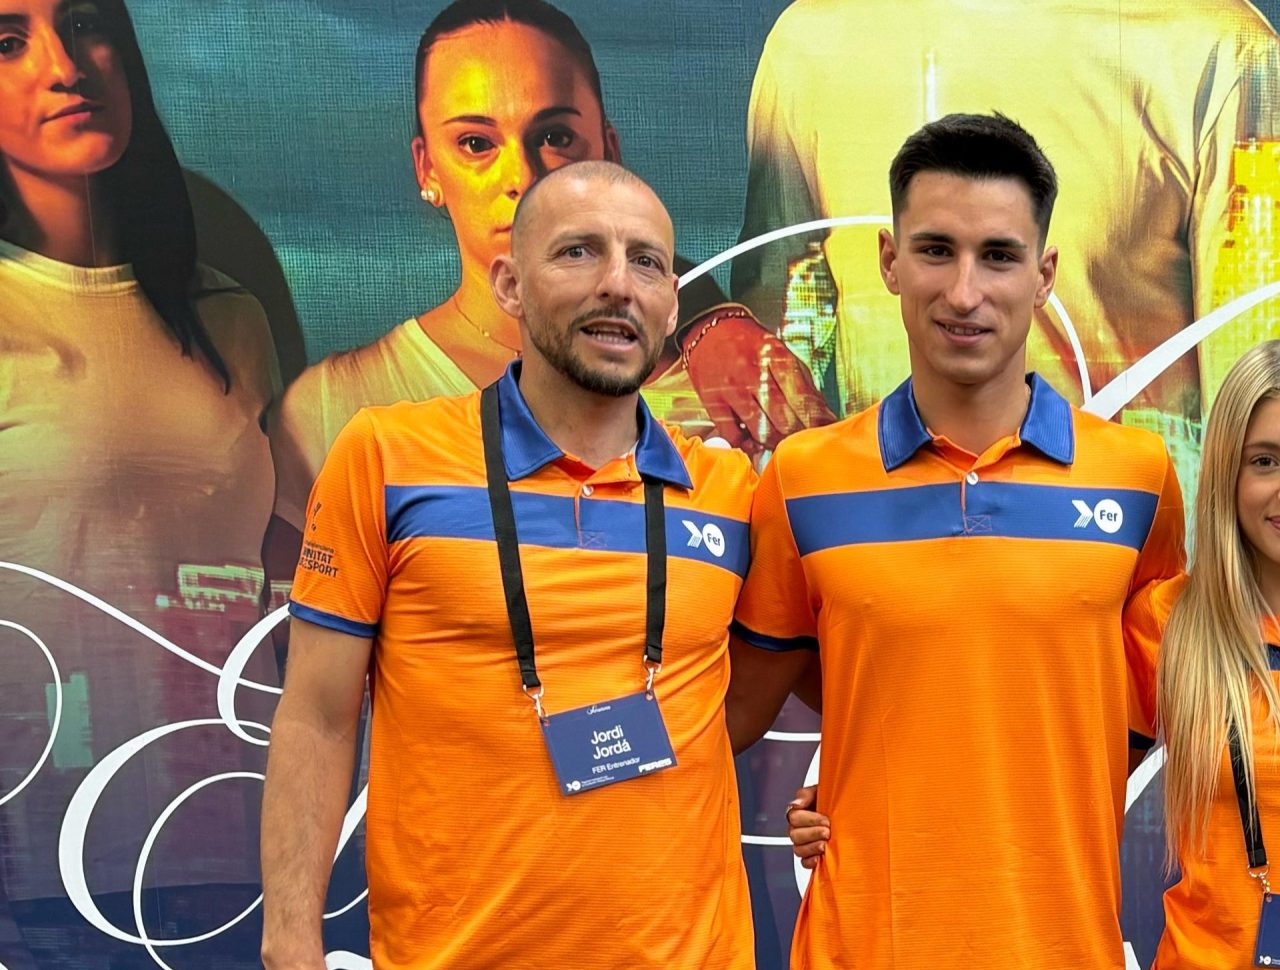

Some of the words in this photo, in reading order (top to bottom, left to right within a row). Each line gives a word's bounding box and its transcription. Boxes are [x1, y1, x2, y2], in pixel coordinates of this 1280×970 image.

[1100, 509, 1118, 522] Fer
[591, 725, 624, 744] Jordi
[593, 739, 631, 760] Jordá
[592, 766, 606, 774] FER
[606, 757, 640, 771] Entrenador
